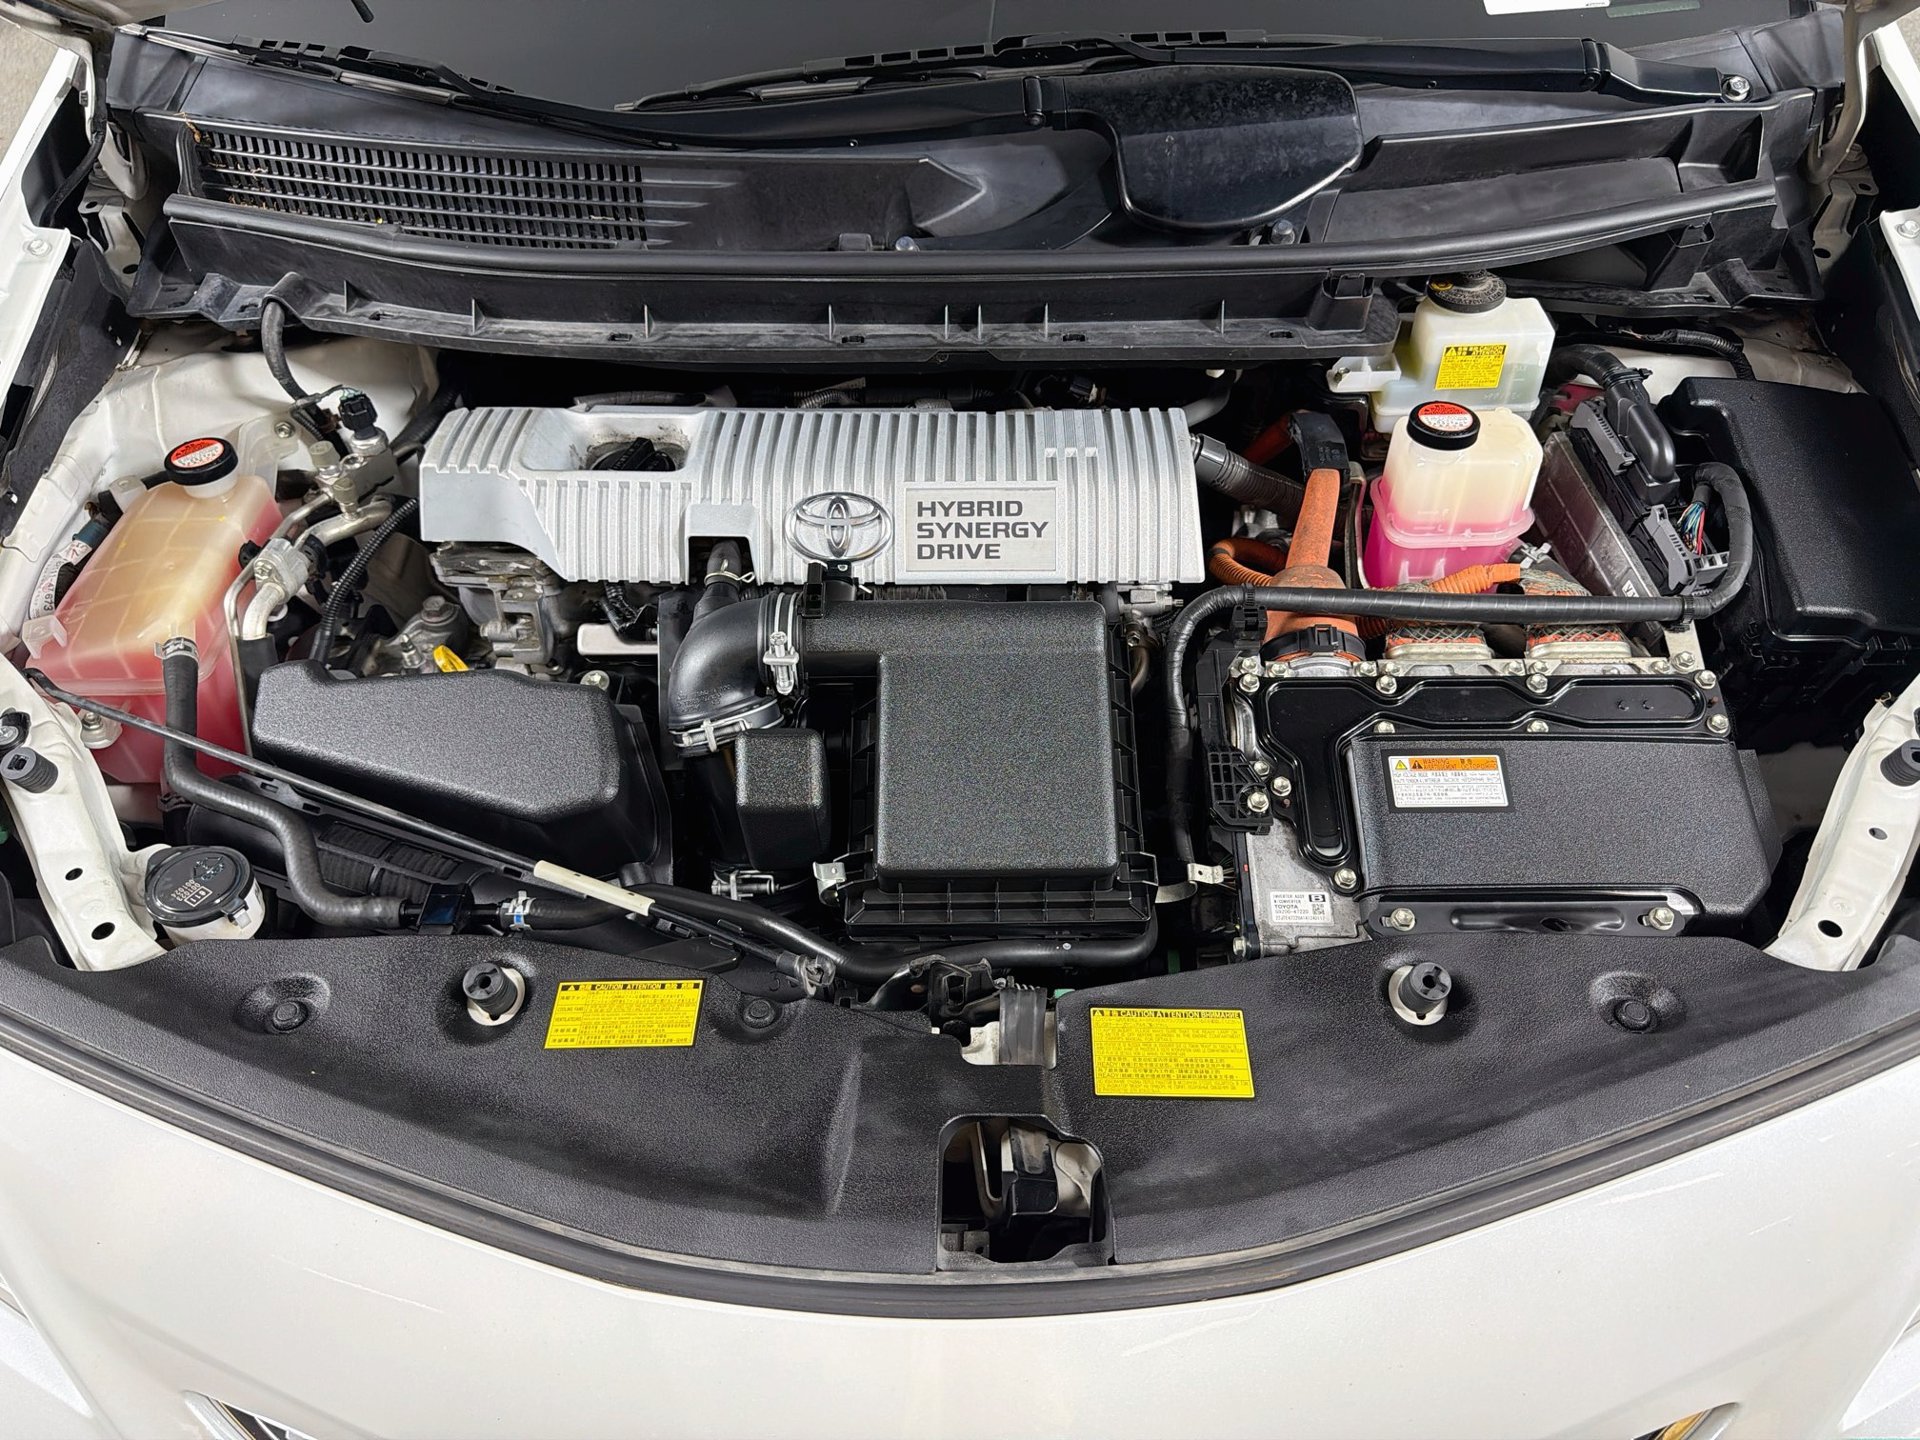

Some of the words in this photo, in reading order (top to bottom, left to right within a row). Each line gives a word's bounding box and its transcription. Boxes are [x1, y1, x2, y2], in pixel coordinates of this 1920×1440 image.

[917, 500, 1023, 517] HYBRID
[916, 521, 1049, 539] SYNERGY
[917, 543, 1001, 560] DRIVE
